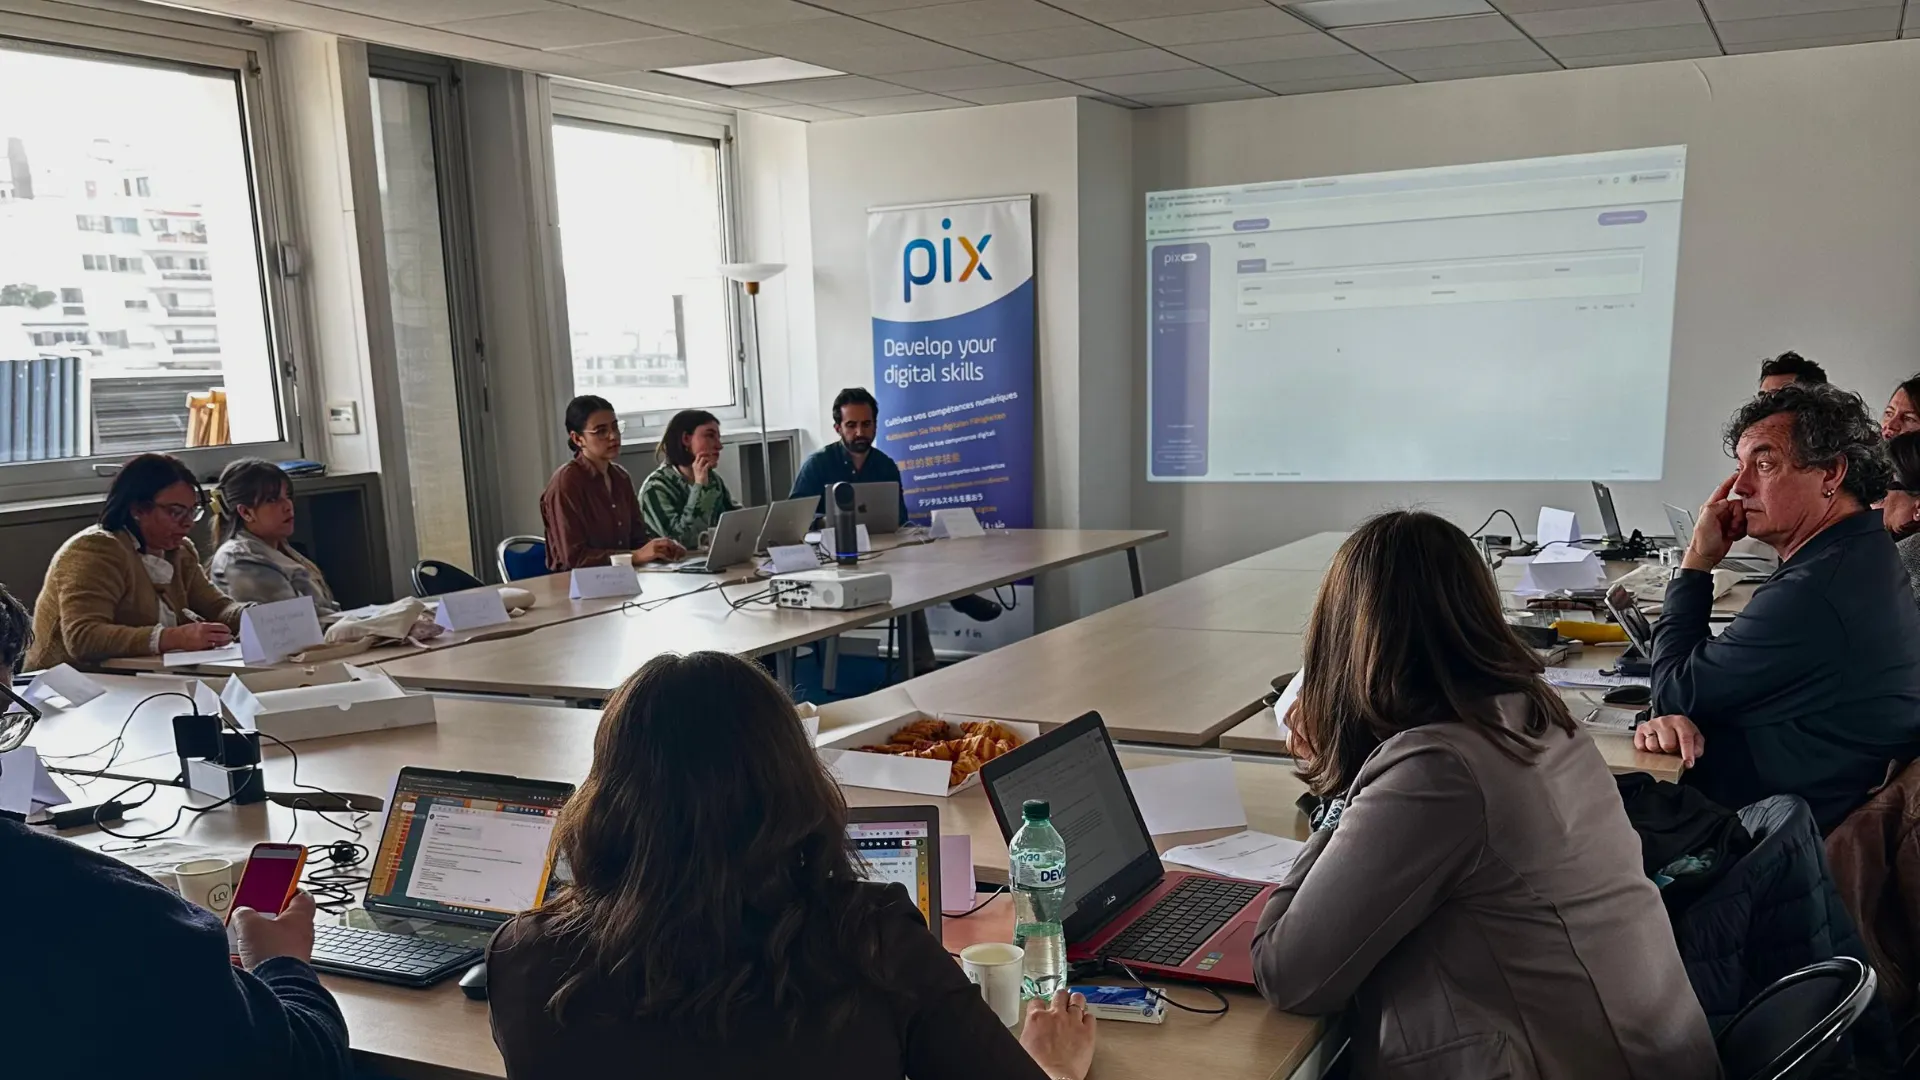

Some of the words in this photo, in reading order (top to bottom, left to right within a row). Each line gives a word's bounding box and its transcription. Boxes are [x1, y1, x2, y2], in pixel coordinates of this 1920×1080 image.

[903, 217, 993, 304] pix
[1163, 251, 1182, 267] pix
[883, 336, 953, 360] Develop
[957, 337, 997, 359] your
[883, 362, 937, 389] digital
[941, 361, 984, 382] skills
[884, 415, 913, 428] Cultivez
[913, 412, 927, 421] vos
[927, 401, 975, 416] compétences
[975, 391, 1018, 407] numériques
